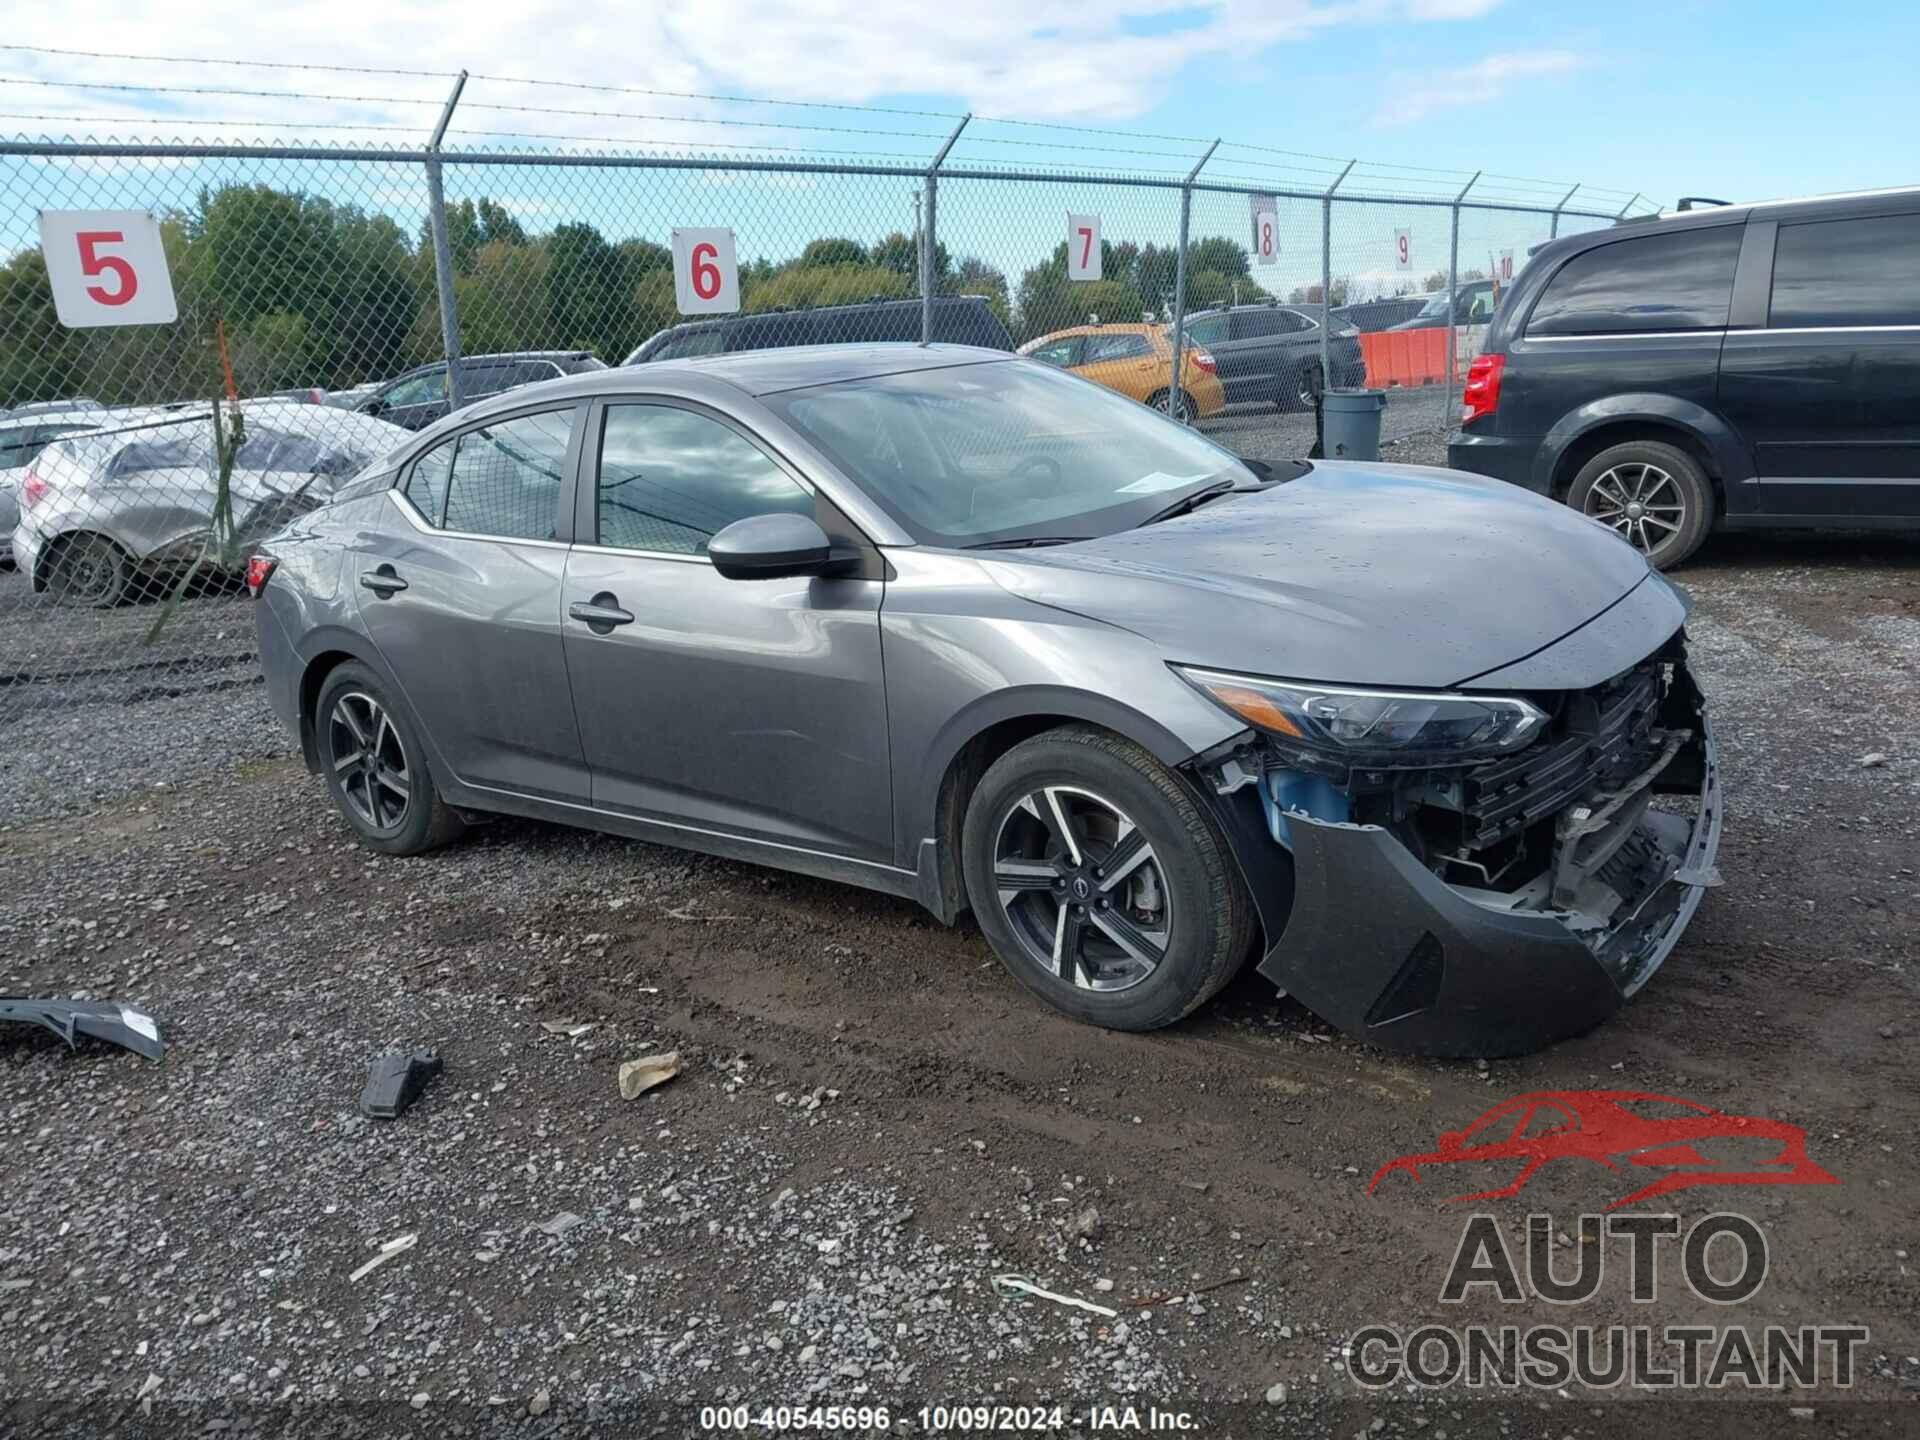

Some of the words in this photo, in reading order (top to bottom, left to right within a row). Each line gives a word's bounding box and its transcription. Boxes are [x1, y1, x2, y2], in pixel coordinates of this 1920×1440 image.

[1078, 227, 1092, 269] 7
[1263, 222, 1272, 257] 8
[1399, 235, 1408, 264] 9
[76, 231, 138, 306] 5
[691, 243, 722, 300] 6
[1501, 255, 1513, 280] 10
